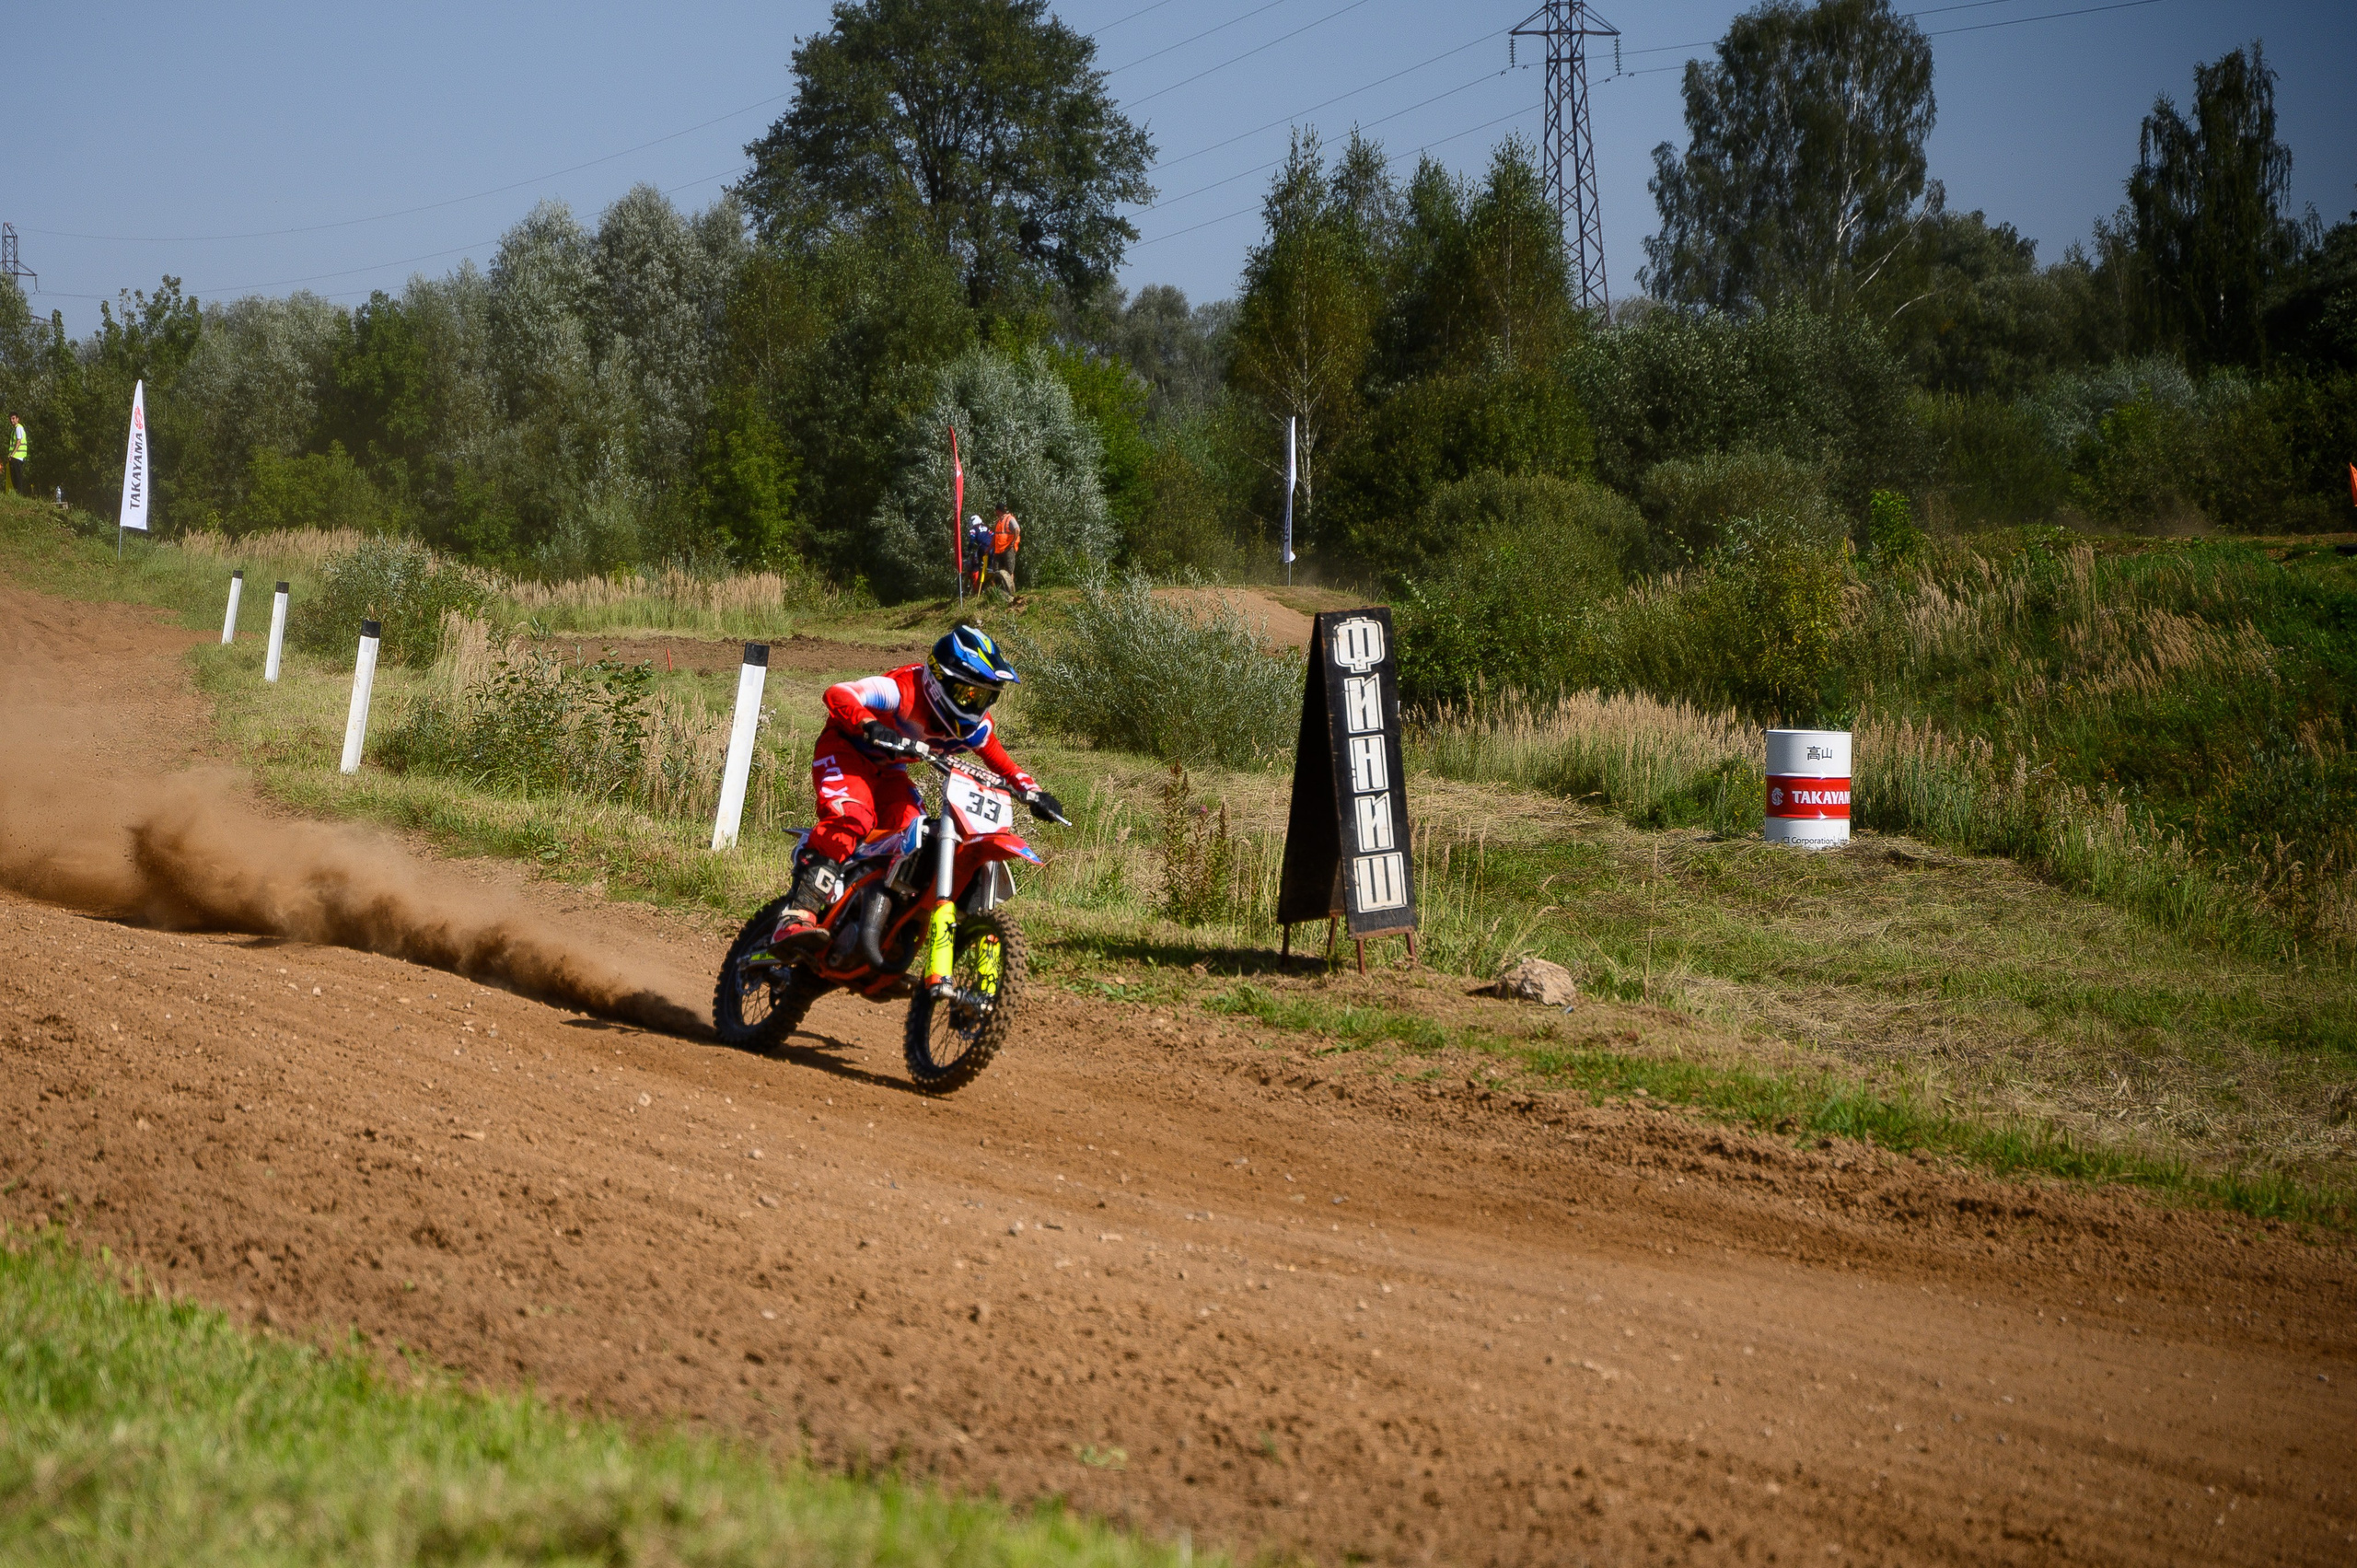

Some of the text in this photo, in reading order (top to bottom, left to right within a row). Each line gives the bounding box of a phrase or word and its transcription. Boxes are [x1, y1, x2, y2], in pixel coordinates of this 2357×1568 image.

[130, 433, 143, 510] TAKAYAMA
[1333, 616, 1409, 913] ФИНИШ
[1806, 746, 1833, 761] 高山
[813, 755, 849, 798] FOX
[966, 791, 1002, 824] 33
[1791, 836, 1834, 845] Corporation
